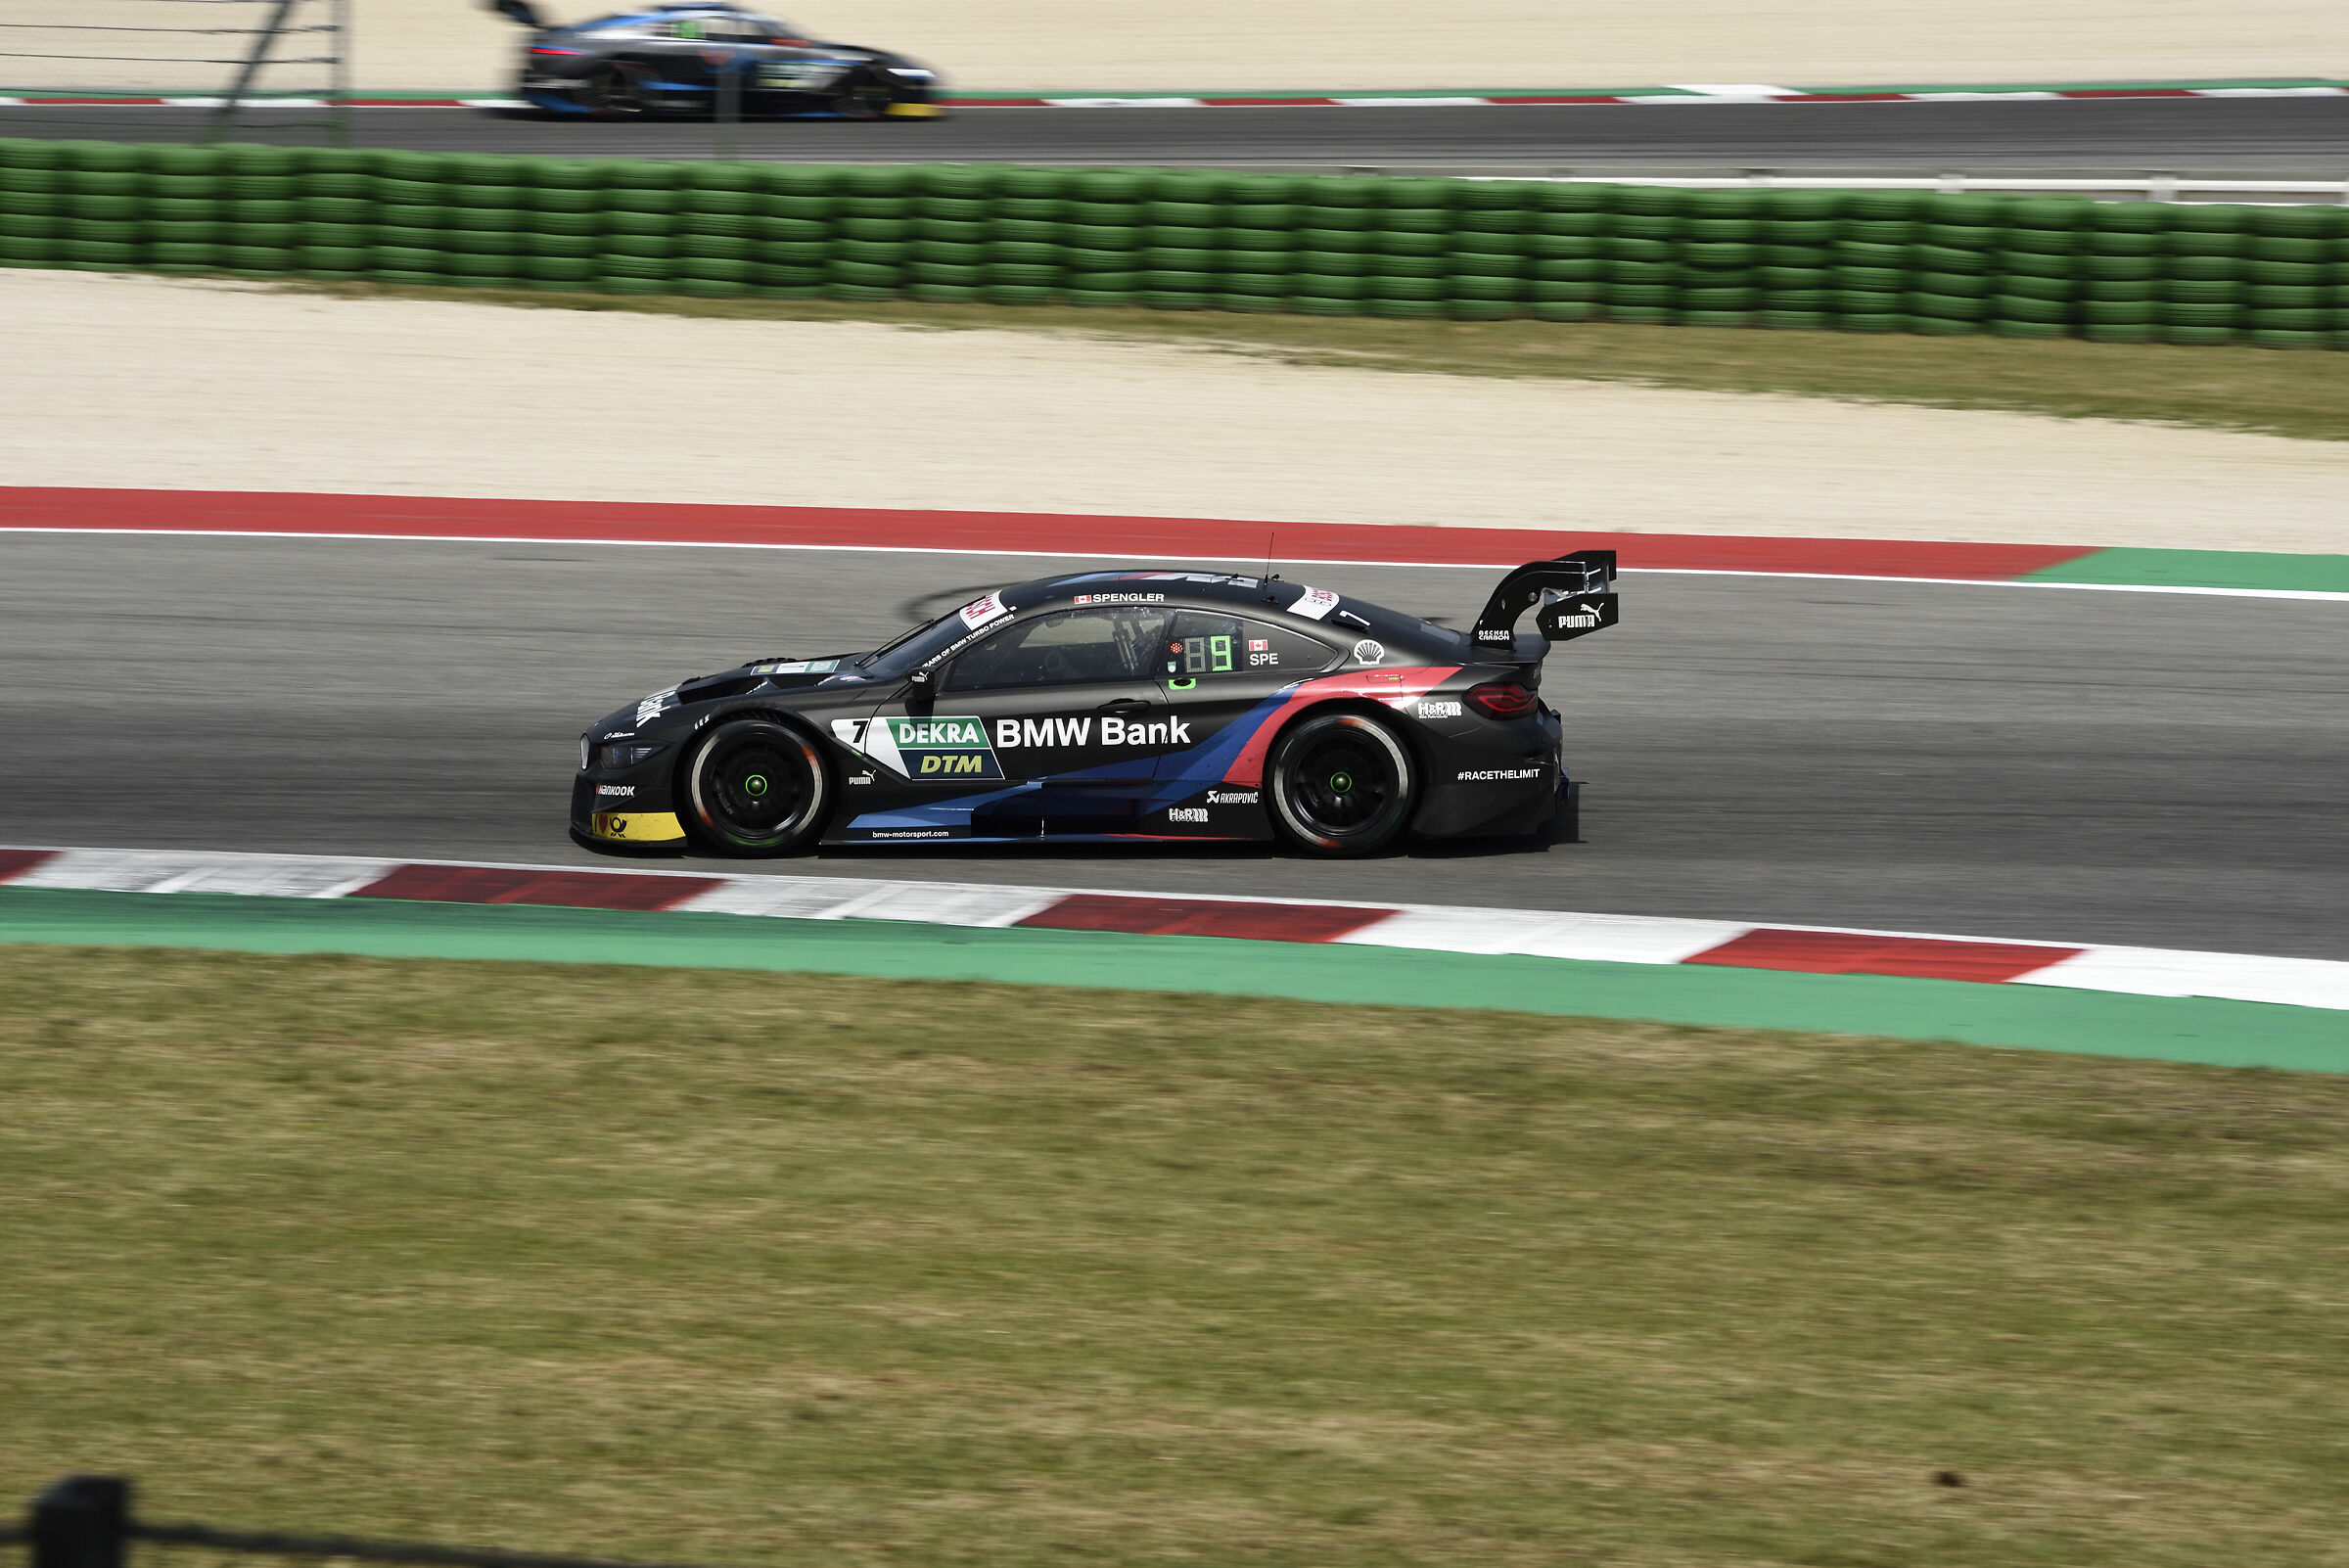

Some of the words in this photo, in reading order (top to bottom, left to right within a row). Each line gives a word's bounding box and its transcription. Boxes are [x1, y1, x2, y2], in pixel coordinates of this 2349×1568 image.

[1092, 593, 1165, 603] SPENGLER
[1558, 615, 1595, 629] PUMA
[941, 648, 951, 658] OF
[949, 637, 967, 652] BMW
[965, 625, 990, 641] TURBO
[989, 614, 1015, 629] POWER
[1249, 653, 1278, 666] SPE
[852, 720, 869, 744] 7
[898, 722, 980, 744] DEKRA
[996, 717, 1091, 748] BMW
[1101, 715, 1191, 746] Bank
[920, 756, 982, 773] DTM
[849, 776, 871, 785] PUMA
[1457, 768, 1540, 781] #RACETHELIMIT
